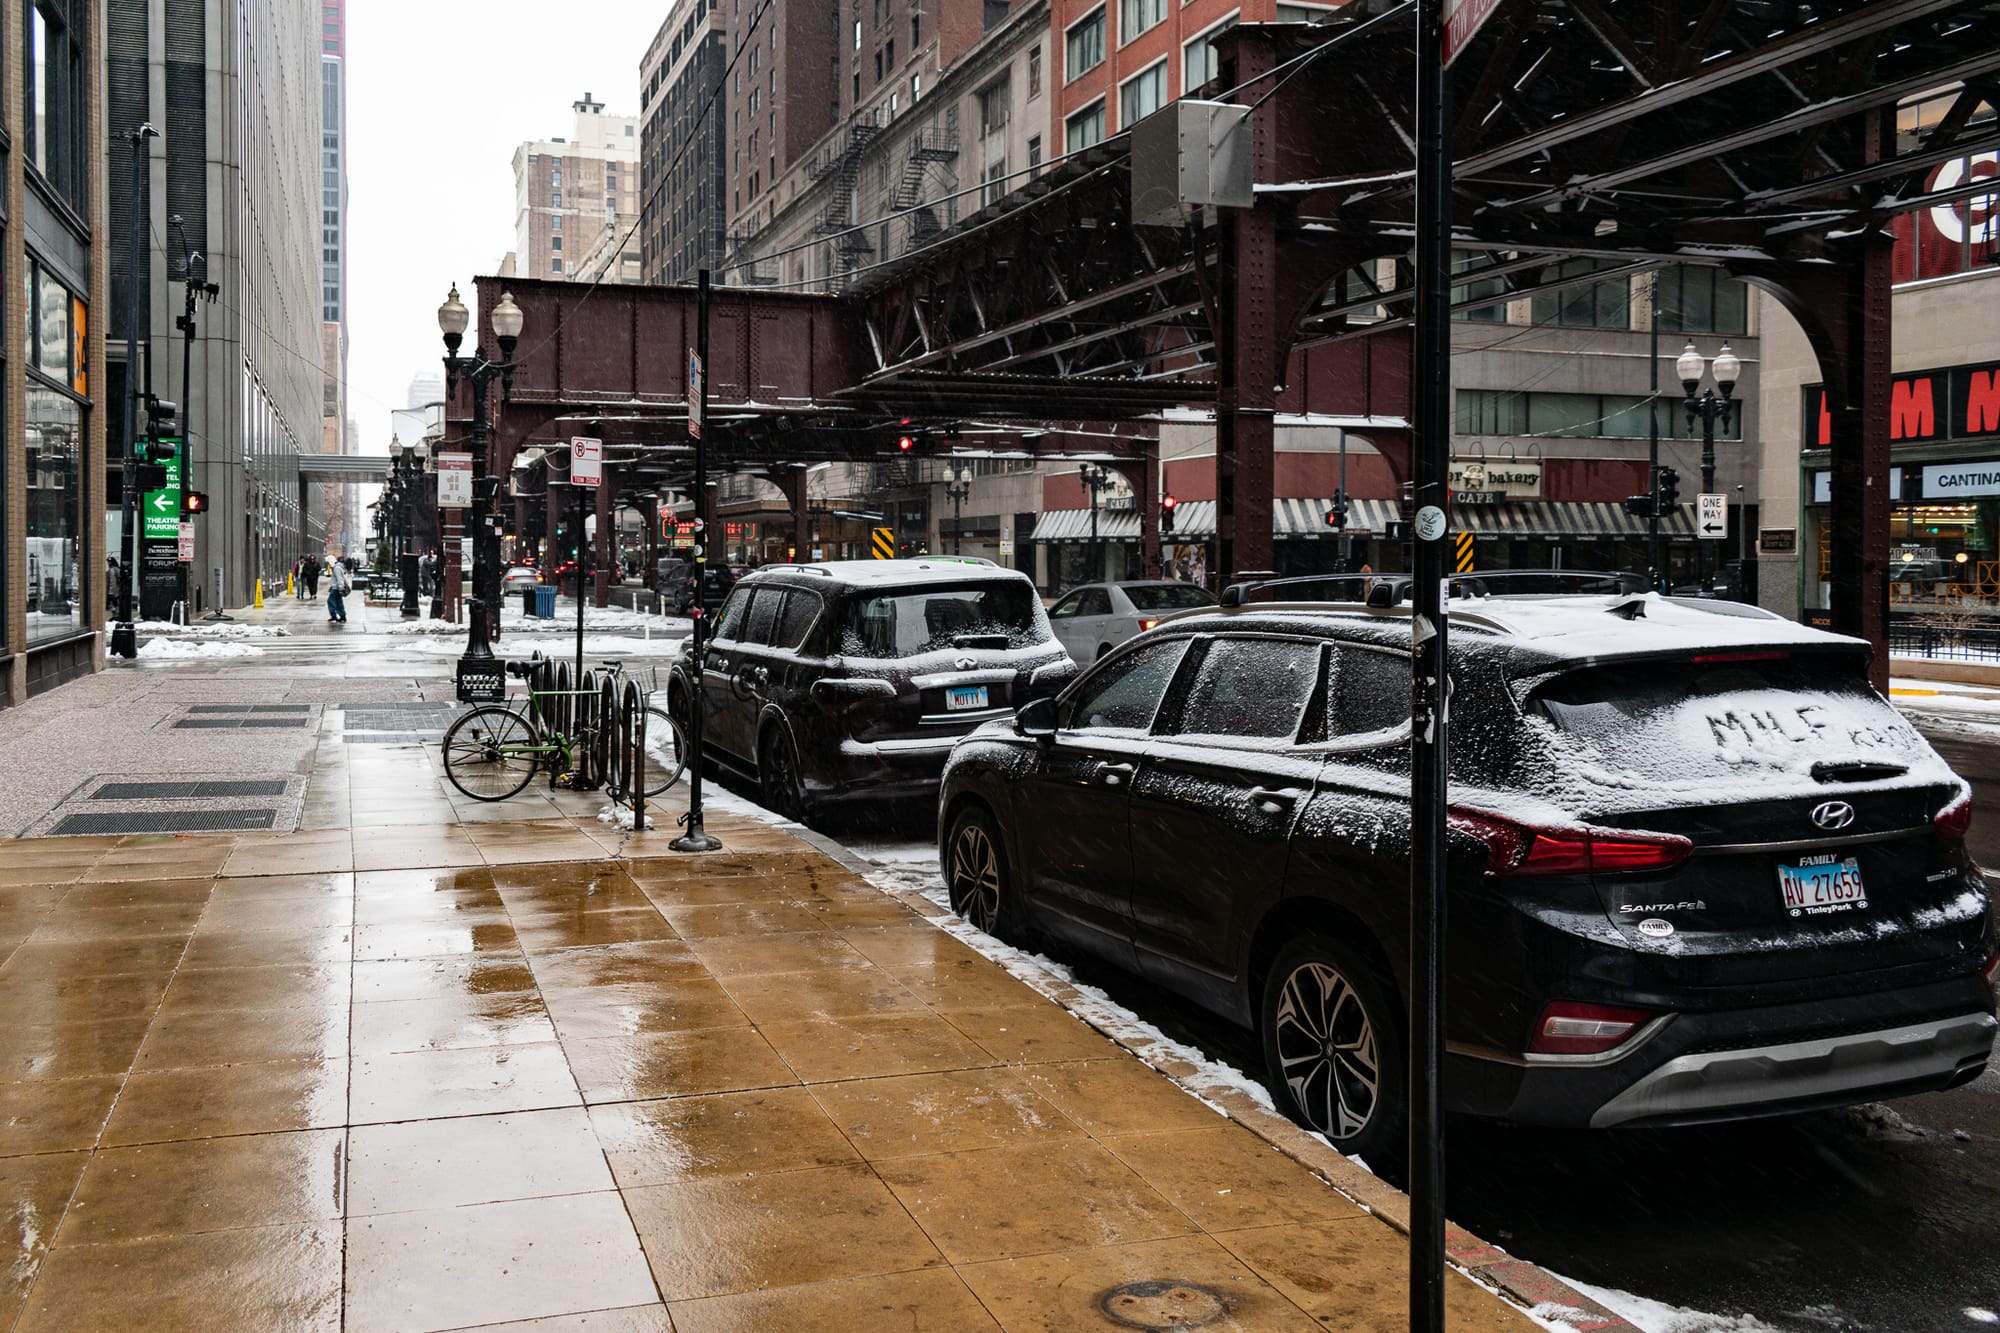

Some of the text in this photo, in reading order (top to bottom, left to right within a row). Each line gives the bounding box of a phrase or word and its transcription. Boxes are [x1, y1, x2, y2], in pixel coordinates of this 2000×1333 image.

[1488, 471, 1538, 486] bakery
[1938, 472, 2000, 487] CANTINA
[1457, 492, 1494, 504] CAFE
[1703, 498, 1721, 508] ONE
[1703, 510, 1722, 520] WAY
[1800, 854, 1838, 867] FAMILY
[1784, 870, 1863, 907] AV 27659
[1620, 903, 1676, 914] SANTA
